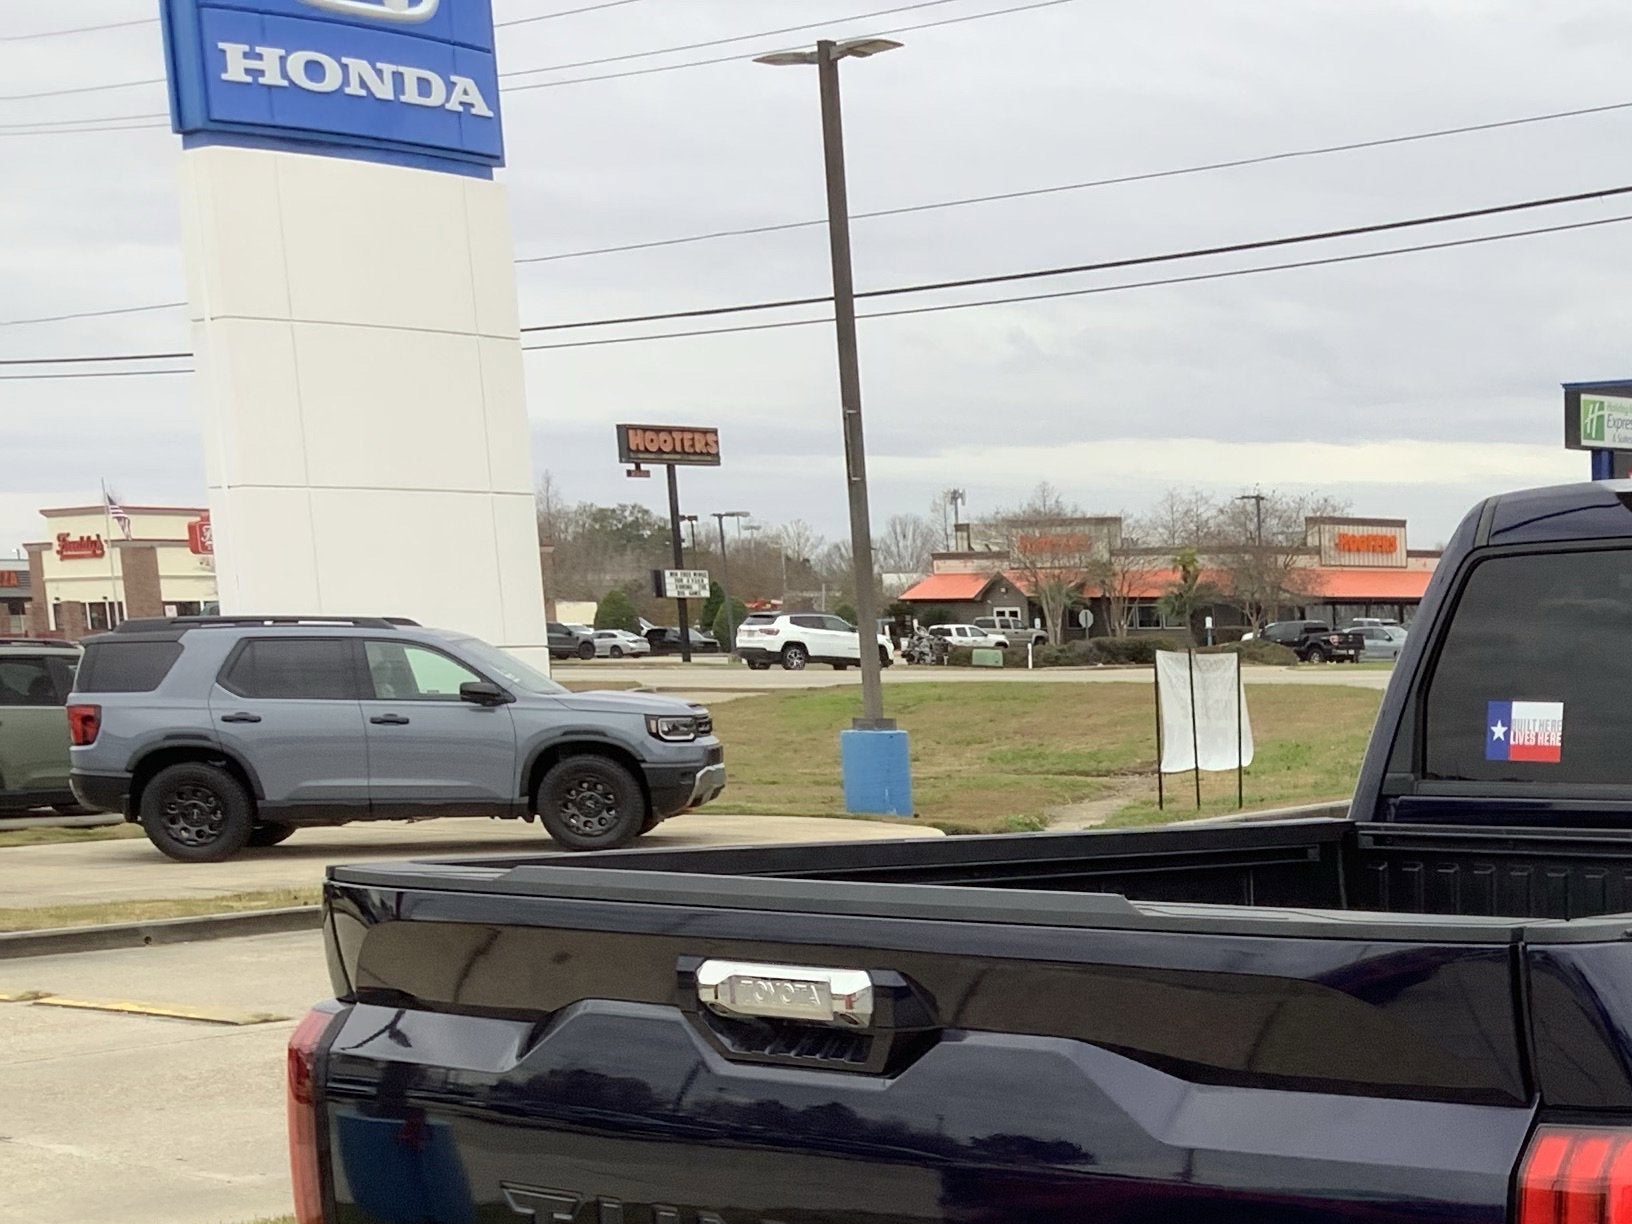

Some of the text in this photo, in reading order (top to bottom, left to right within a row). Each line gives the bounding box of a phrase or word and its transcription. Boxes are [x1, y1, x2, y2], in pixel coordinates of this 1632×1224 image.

[217, 42, 494, 118] HONDA
[628, 429, 719, 454] HOOTERS
[1512, 719, 1562, 733] BUILT HERE
[1509, 731, 1562, 747] LIVES HERE
